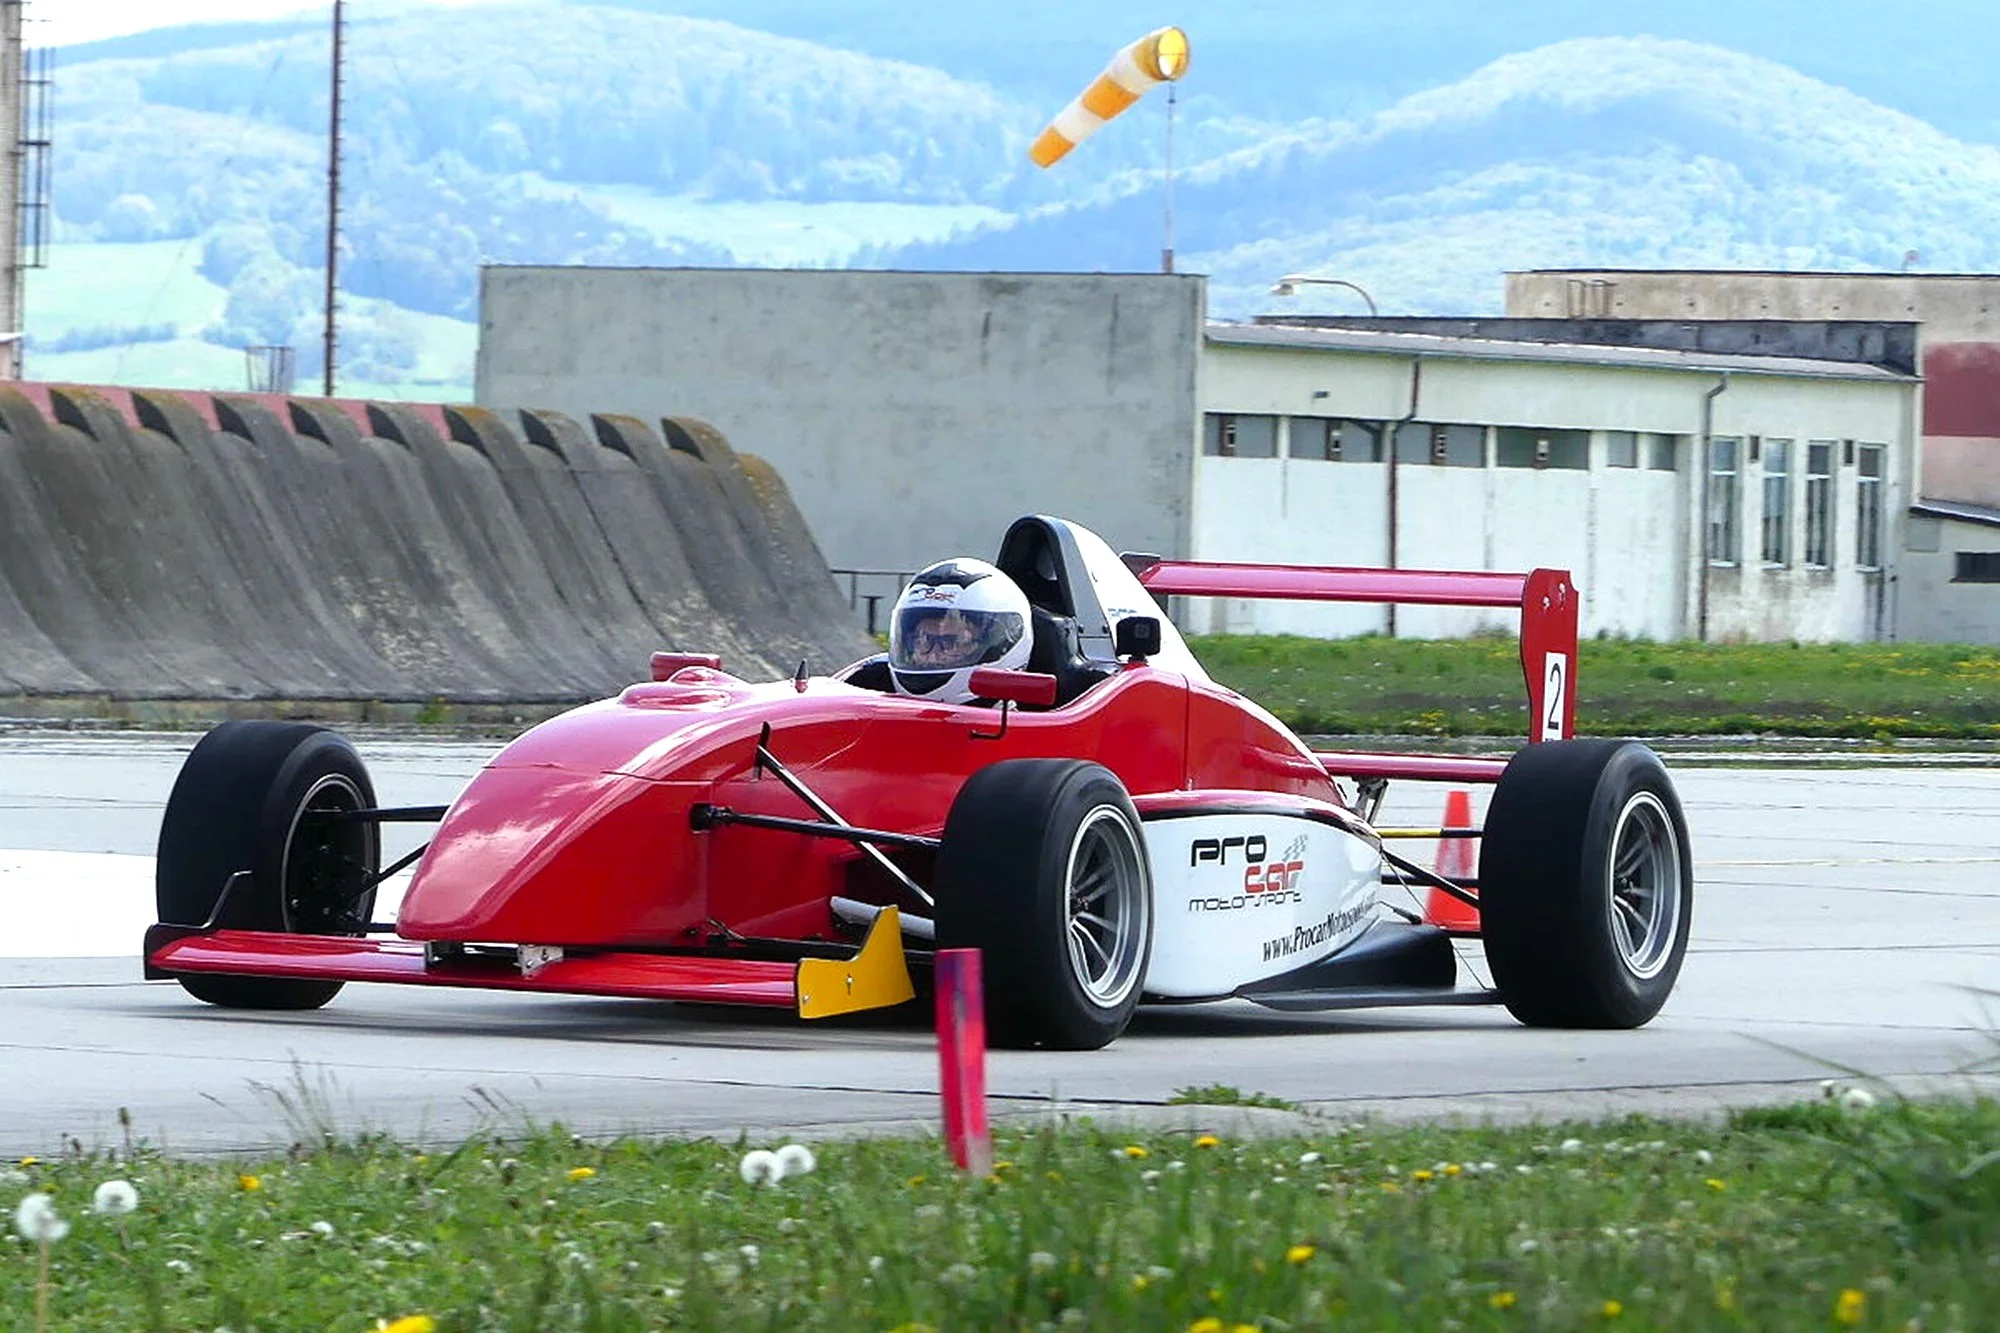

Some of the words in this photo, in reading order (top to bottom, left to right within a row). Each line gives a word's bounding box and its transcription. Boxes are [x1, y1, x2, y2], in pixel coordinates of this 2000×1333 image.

[1548, 663, 1562, 730] 2
[1191, 835, 1267, 867] pro
[1245, 861, 1304, 893] car
[1189, 891, 1302, 911] motorsport
